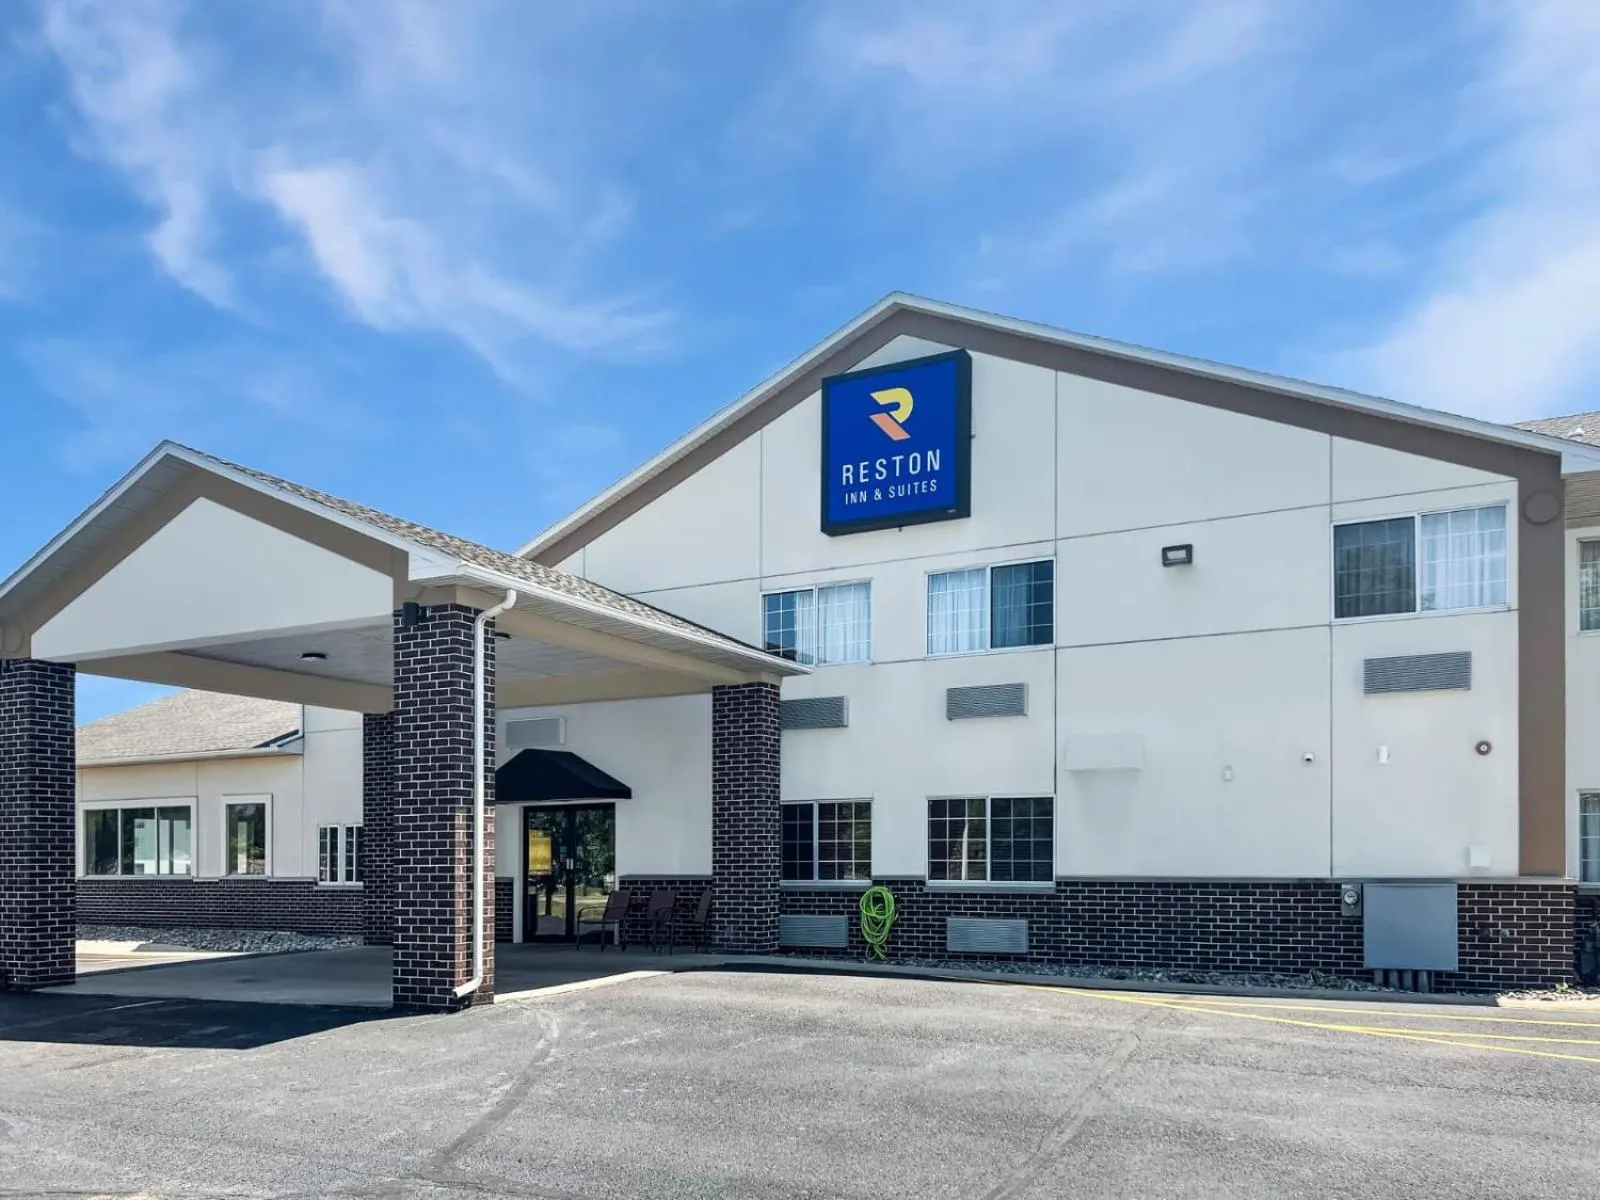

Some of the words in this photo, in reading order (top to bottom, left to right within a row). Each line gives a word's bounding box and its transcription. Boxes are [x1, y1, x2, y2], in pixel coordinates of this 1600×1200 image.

[842, 449, 941, 486] RESTON
[845, 491, 867, 505] INN
[874, 488, 883, 501] &
[888, 479, 937, 498] SUITES
